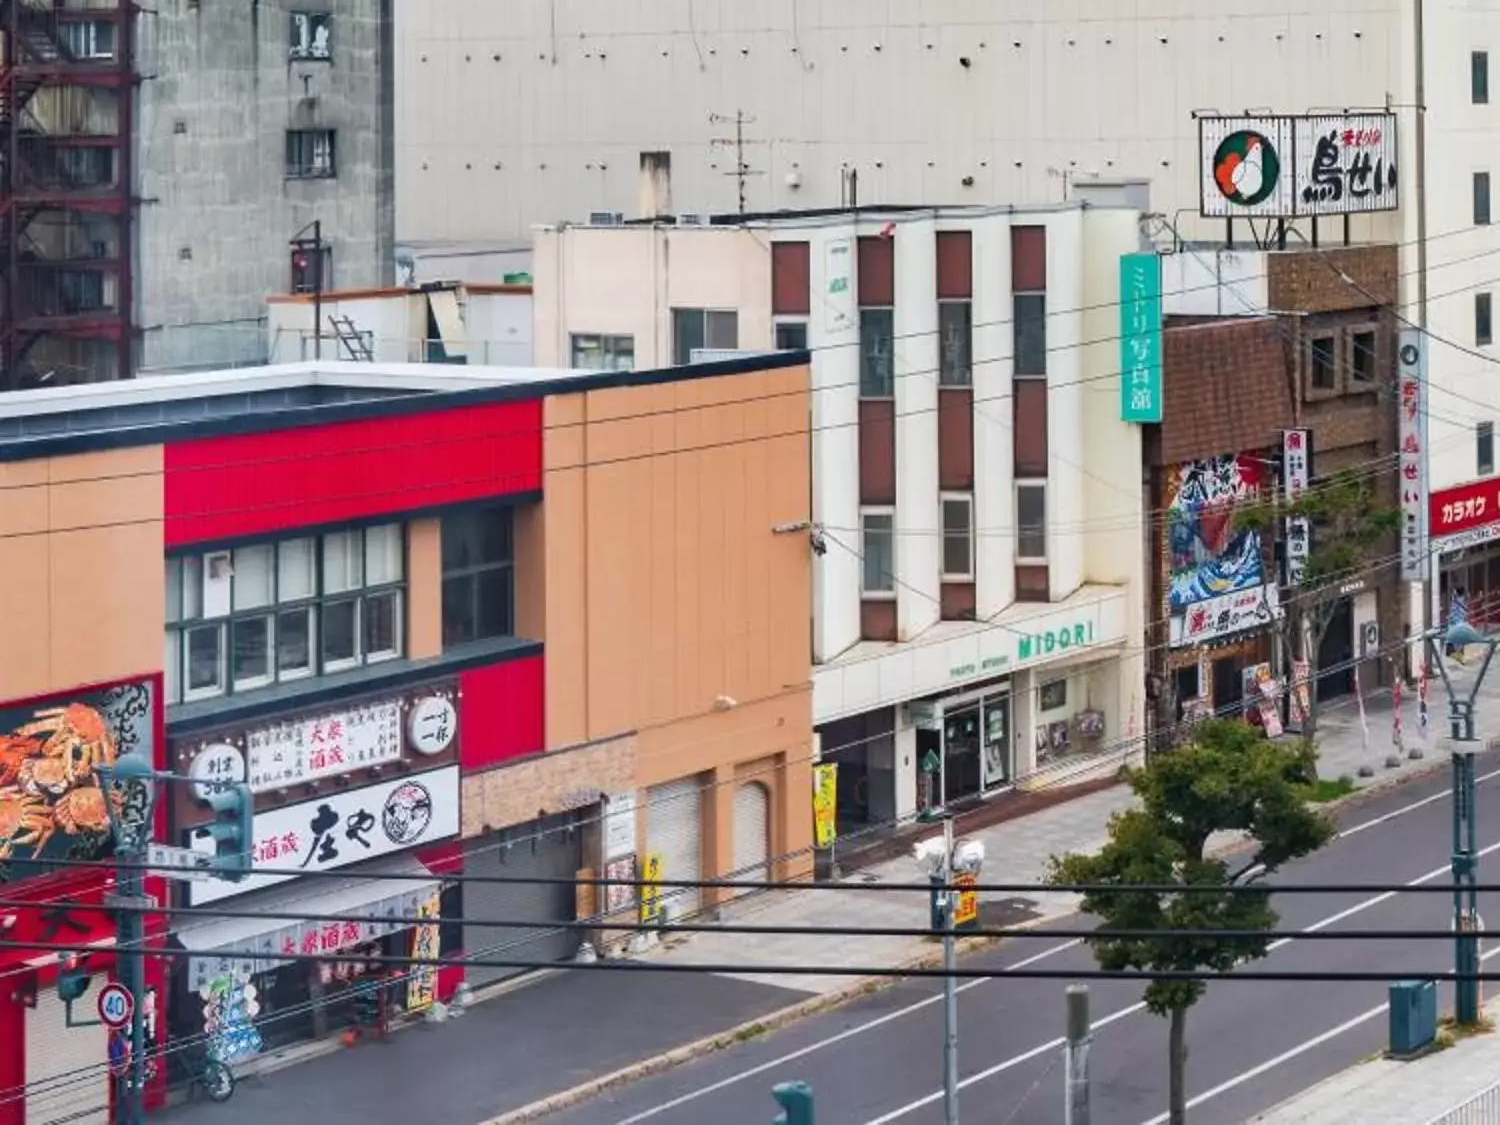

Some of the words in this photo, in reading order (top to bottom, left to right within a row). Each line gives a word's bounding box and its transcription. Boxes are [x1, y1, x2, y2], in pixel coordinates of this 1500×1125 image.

[1302, 130, 1397, 204] 鳥せい
[1442, 496, 1486, 523] カラオケ
[1018, 620, 1093, 660] MIDORI
[300, 803, 375, 868] 庄や
[106, 996, 125, 1016] 40
